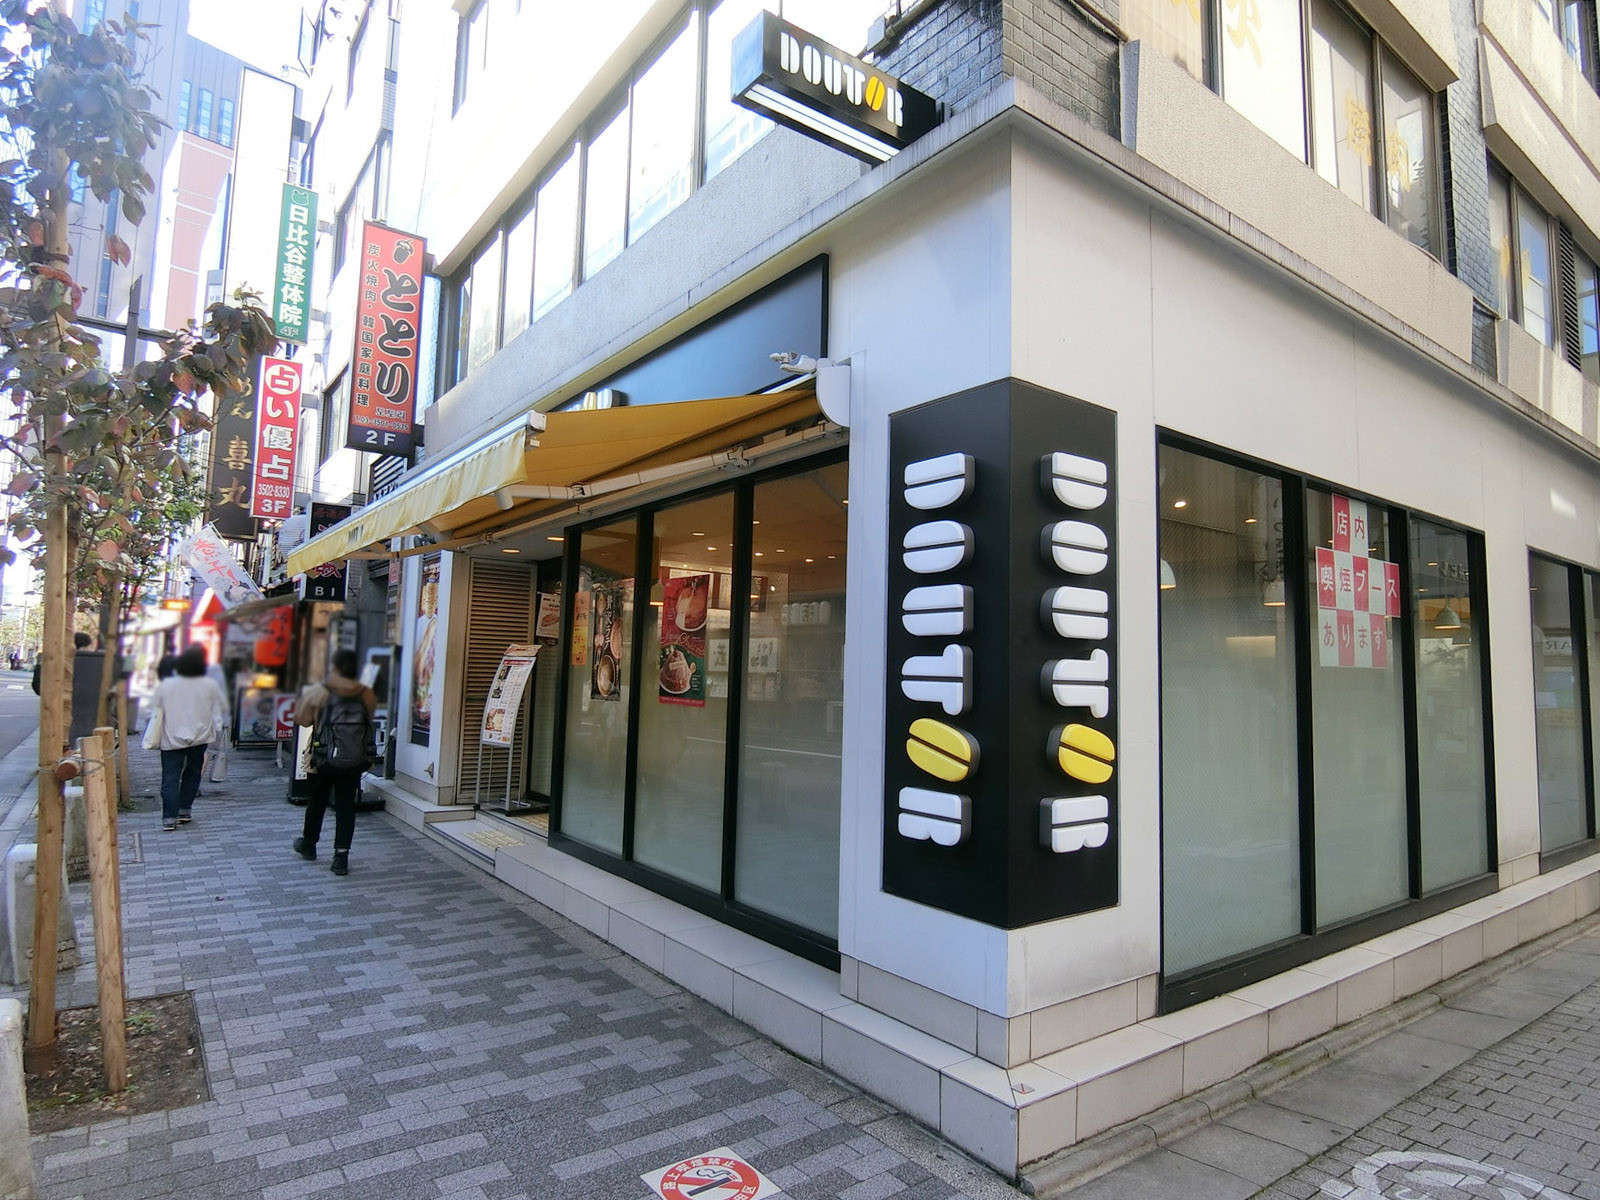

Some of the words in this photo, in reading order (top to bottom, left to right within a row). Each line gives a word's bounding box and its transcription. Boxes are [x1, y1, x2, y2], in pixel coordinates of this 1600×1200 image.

[779, 31, 904, 128] DOUTOR
[279, 203, 309, 326] 日比谷整体院
[376, 268, 420, 405] ととり
[262, 365, 299, 480] 占い優占
[258, 483, 290, 498] 3502-8330
[260, 499, 288, 514] 3F
[1336, 510, 1365, 540] 店内
[1320, 565, 1398, 598] 喫煙ブース
[898, 452, 972, 847] DOUTOR
[1050, 452, 1115, 853] DOUTOR
[1323, 621, 1383, 651] あります
[662, 1157, 736, 1190] 路上喫煙禁止
